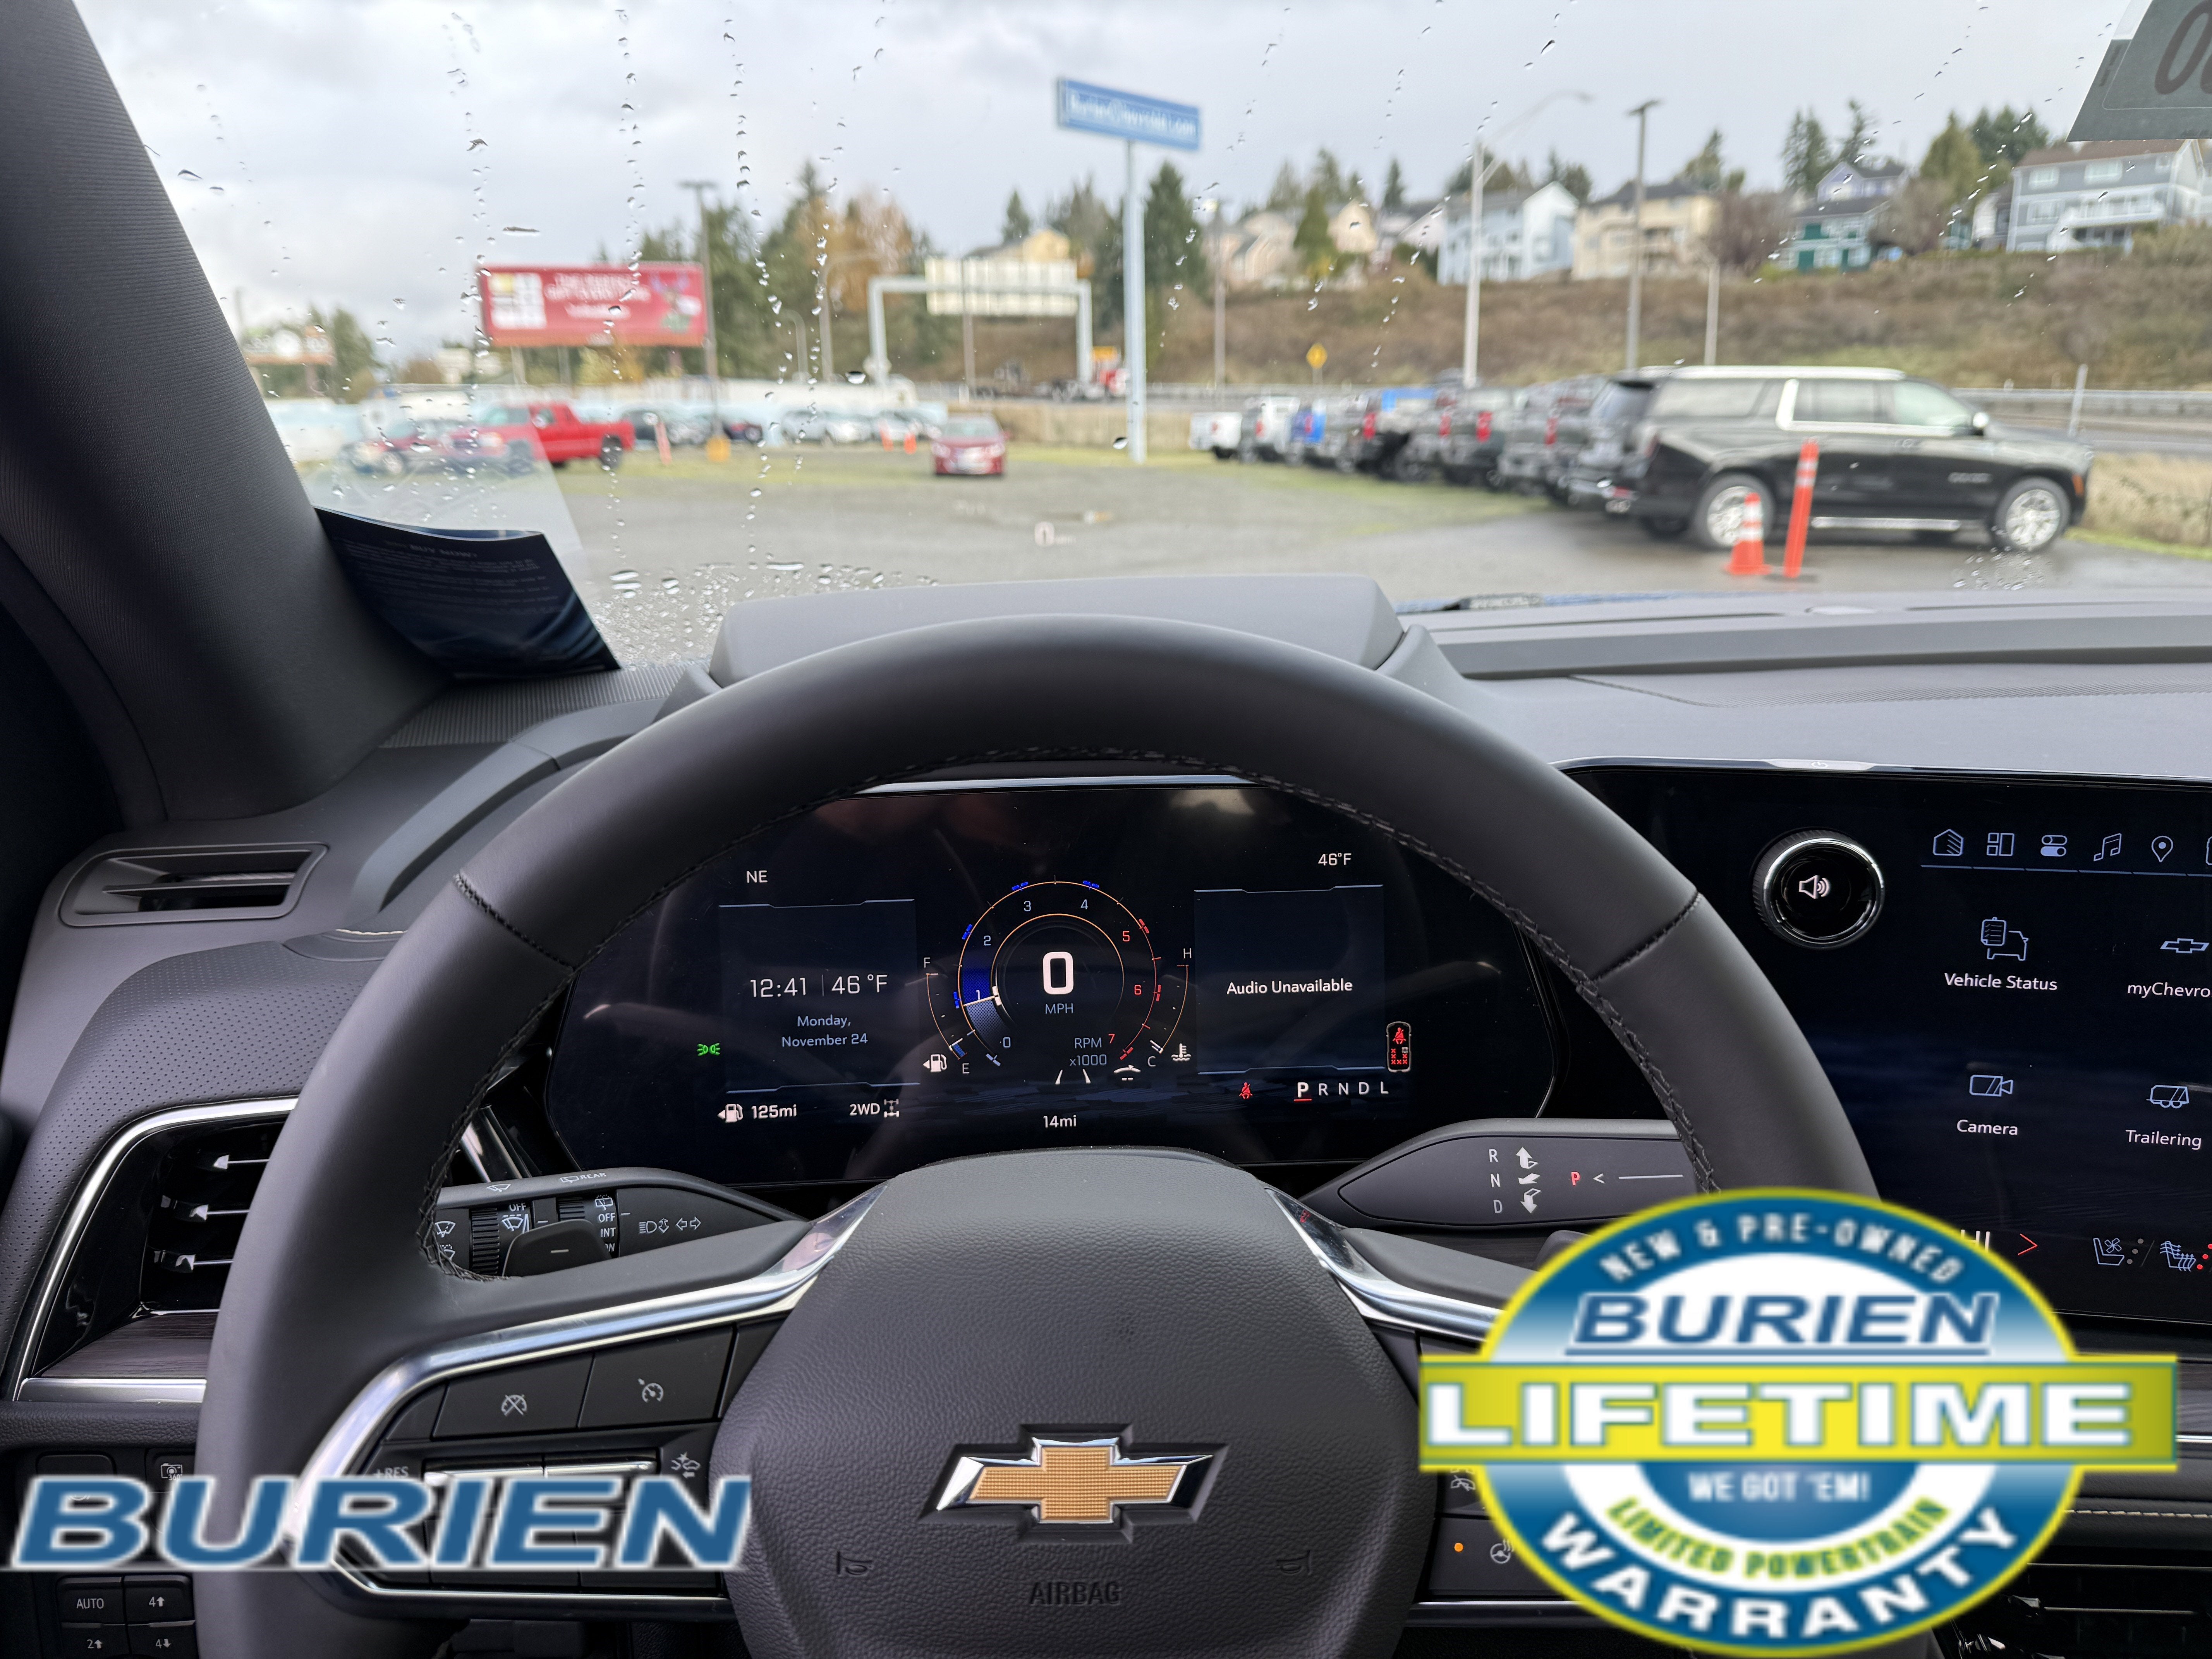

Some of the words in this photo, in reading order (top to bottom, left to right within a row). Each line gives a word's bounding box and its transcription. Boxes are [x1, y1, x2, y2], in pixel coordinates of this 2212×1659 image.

[1318, 852, 1352, 866] 46°F
[746, 870, 768, 883] NE
[1024, 901, 1031, 912] 3
[1080, 899, 1089, 910] 4
[984, 936, 991, 946] 2
[1122, 931, 1130, 942] 5
[1183, 948, 1192, 958] H
[924, 957, 931, 968] F
[1042, 951, 1074, 995] 0
[750, 977, 806, 998] 12:41
[831, 975, 860, 994] 46
[1226, 981, 1268, 995] Audio
[1271, 978, 1353, 993] Unavailable
[1944, 972, 2001, 988] Vehicle
[2006, 975, 2057, 991] Status
[975, 990, 981, 1000] 1
[1134, 984, 1141, 995] 6
[2127, 982, 2212, 998] myChevro
[1045, 1003, 1074, 1014] MPH
[797, 1015, 851, 1027] Monday,
[782, 1035, 847, 1048] November
[851, 1033, 868, 1044] 24
[1003, 1037, 1011, 1048] 0
[1074, 1037, 1102, 1048] RPM
[1108, 1033, 1115, 1044] 7
[1070, 1054, 1107, 1066] x1000
[1147, 1056, 1156, 1067] C
[962, 1063, 970, 1074] E
[1297, 1082, 1309, 1097] P
[1319, 1083, 1329, 1096] R
[1338, 1082, 1349, 1095] N
[1358, 1082, 1370, 1094] D
[1380, 1081, 1389, 1094] L
[751, 1104, 797, 1119] 125mi
[850, 1103, 880, 1116] 2WD
[1043, 1115, 1077, 1128] 14mi
[1957, 1119, 2018, 1135] Camera
[2126, 1130, 2202, 1151] Trailering
[1489, 1149, 1499, 1162] R
[1491, 1173, 1501, 1187] N
[1571, 1171, 1580, 1185] P
[509, 1203, 526, 1212] OFF
[1493, 1199, 1503, 1213] D
[599, 1212, 615, 1223] OFF
[601, 1227, 616, 1238] INT
[1029, 1582, 1121, 1605] AIRBAG
[76, 1598, 105, 1610] AUTO
[148, 1597, 156, 1607] 4
[87, 1639, 94, 1649] 2
[155, 1638, 162, 1649] 4
